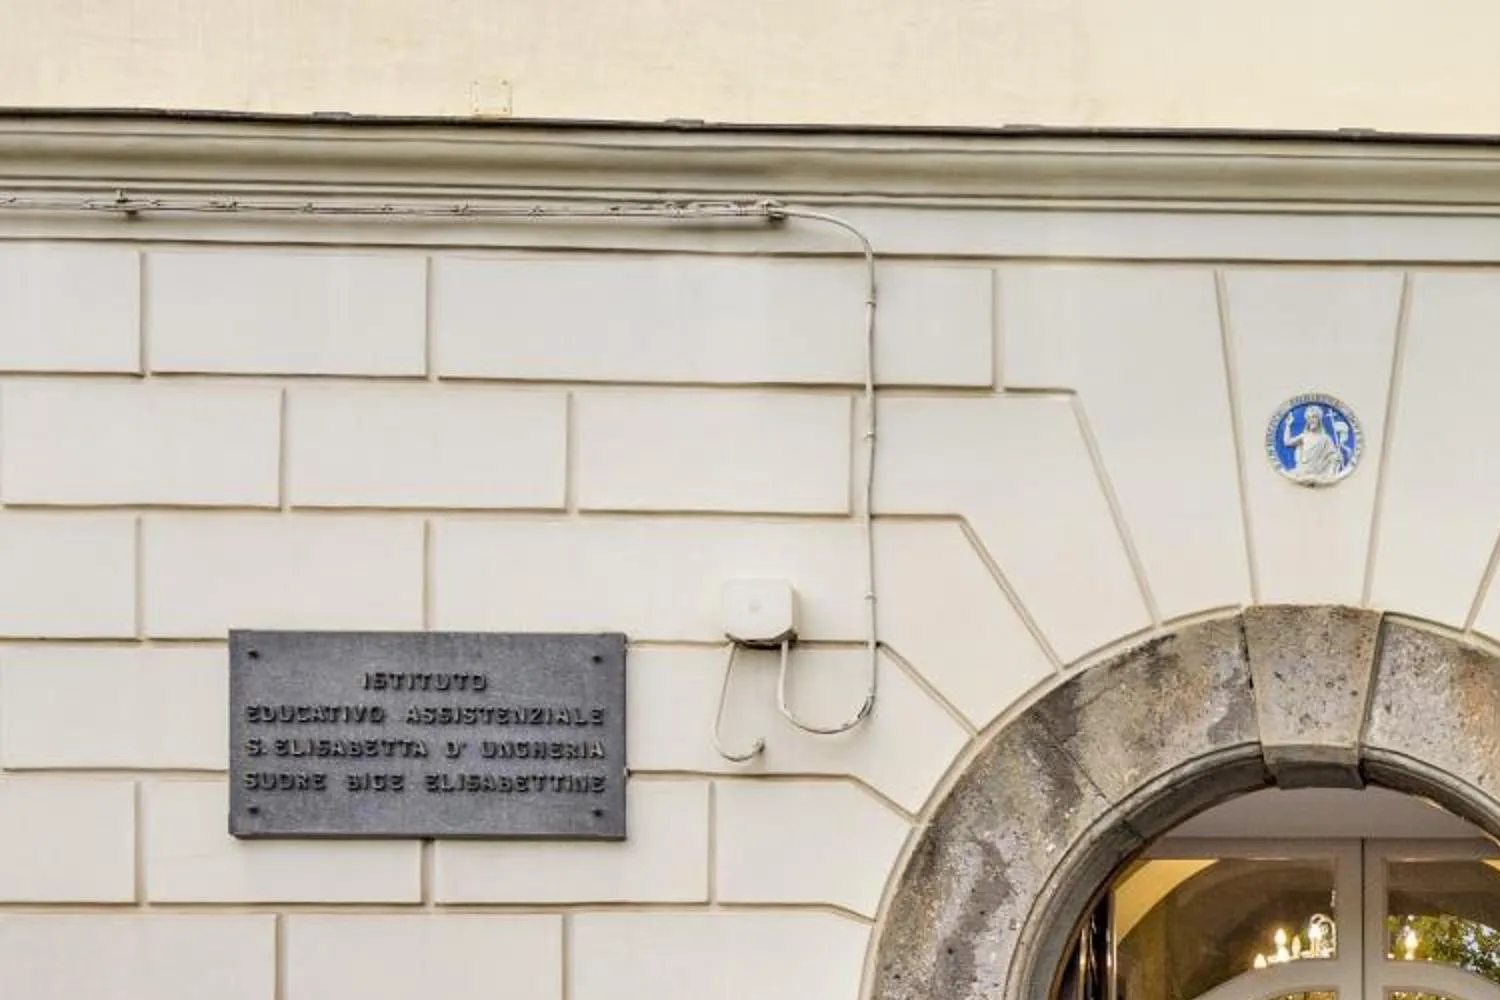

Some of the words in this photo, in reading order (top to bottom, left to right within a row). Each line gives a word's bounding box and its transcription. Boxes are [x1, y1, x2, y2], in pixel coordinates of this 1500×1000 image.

[362, 671, 488, 692] ISTITUTO
[246, 704, 386, 726] EDUCATIVO
[405, 704, 606, 726] ASSISTENZIALE
[243, 771, 328, 792] SUORE
[425, 771, 607, 793] ELISABETTINE
